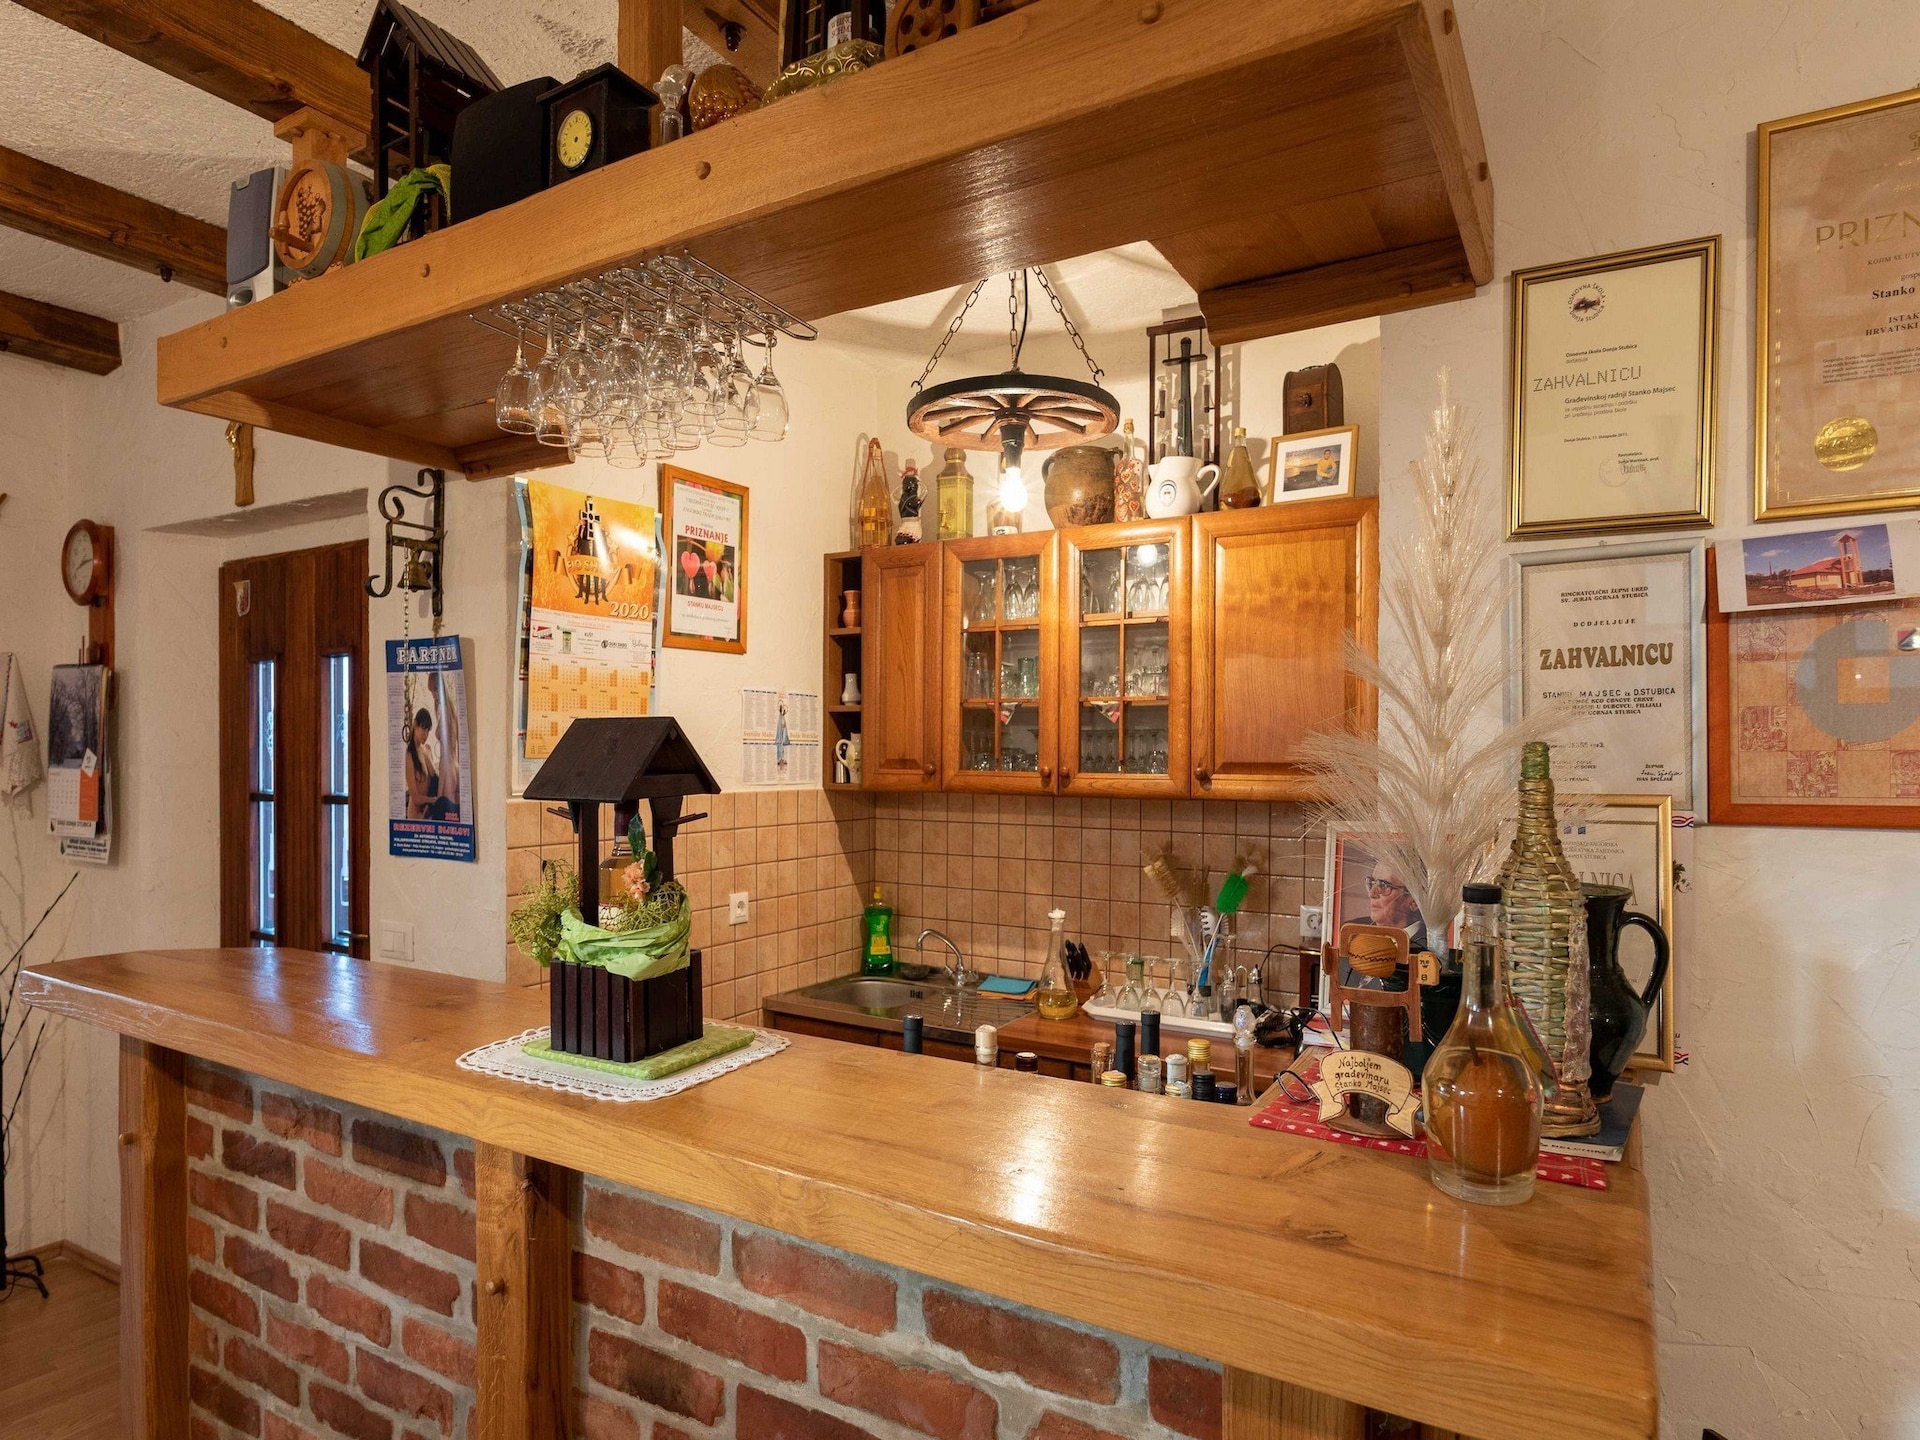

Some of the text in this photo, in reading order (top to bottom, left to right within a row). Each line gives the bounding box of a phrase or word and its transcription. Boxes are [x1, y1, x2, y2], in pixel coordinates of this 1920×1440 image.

[1872, 286, 1916, 300] Stanko
[1865, 321, 1919, 336] HRVATSKI
[1533, 366, 1642, 392] ZAHVALNICU
[1628, 388, 1651, 397] Stanko
[1652, 385, 1676, 396] Majsec
[685, 524, 729, 544] PRIZNANJE
[609, 600, 650, 620] 2020
[1573, 618, 1636, 628] DODJELJUJE
[396, 645, 458, 665] PARTNER
[1540, 642, 1674, 670] ZAHVALNICU
[1579, 689, 1621, 698] MAJSEC
[1338, 1055, 1382, 1071] Najboljem
[1334, 1079, 1392, 1095] Stanko Majsec
